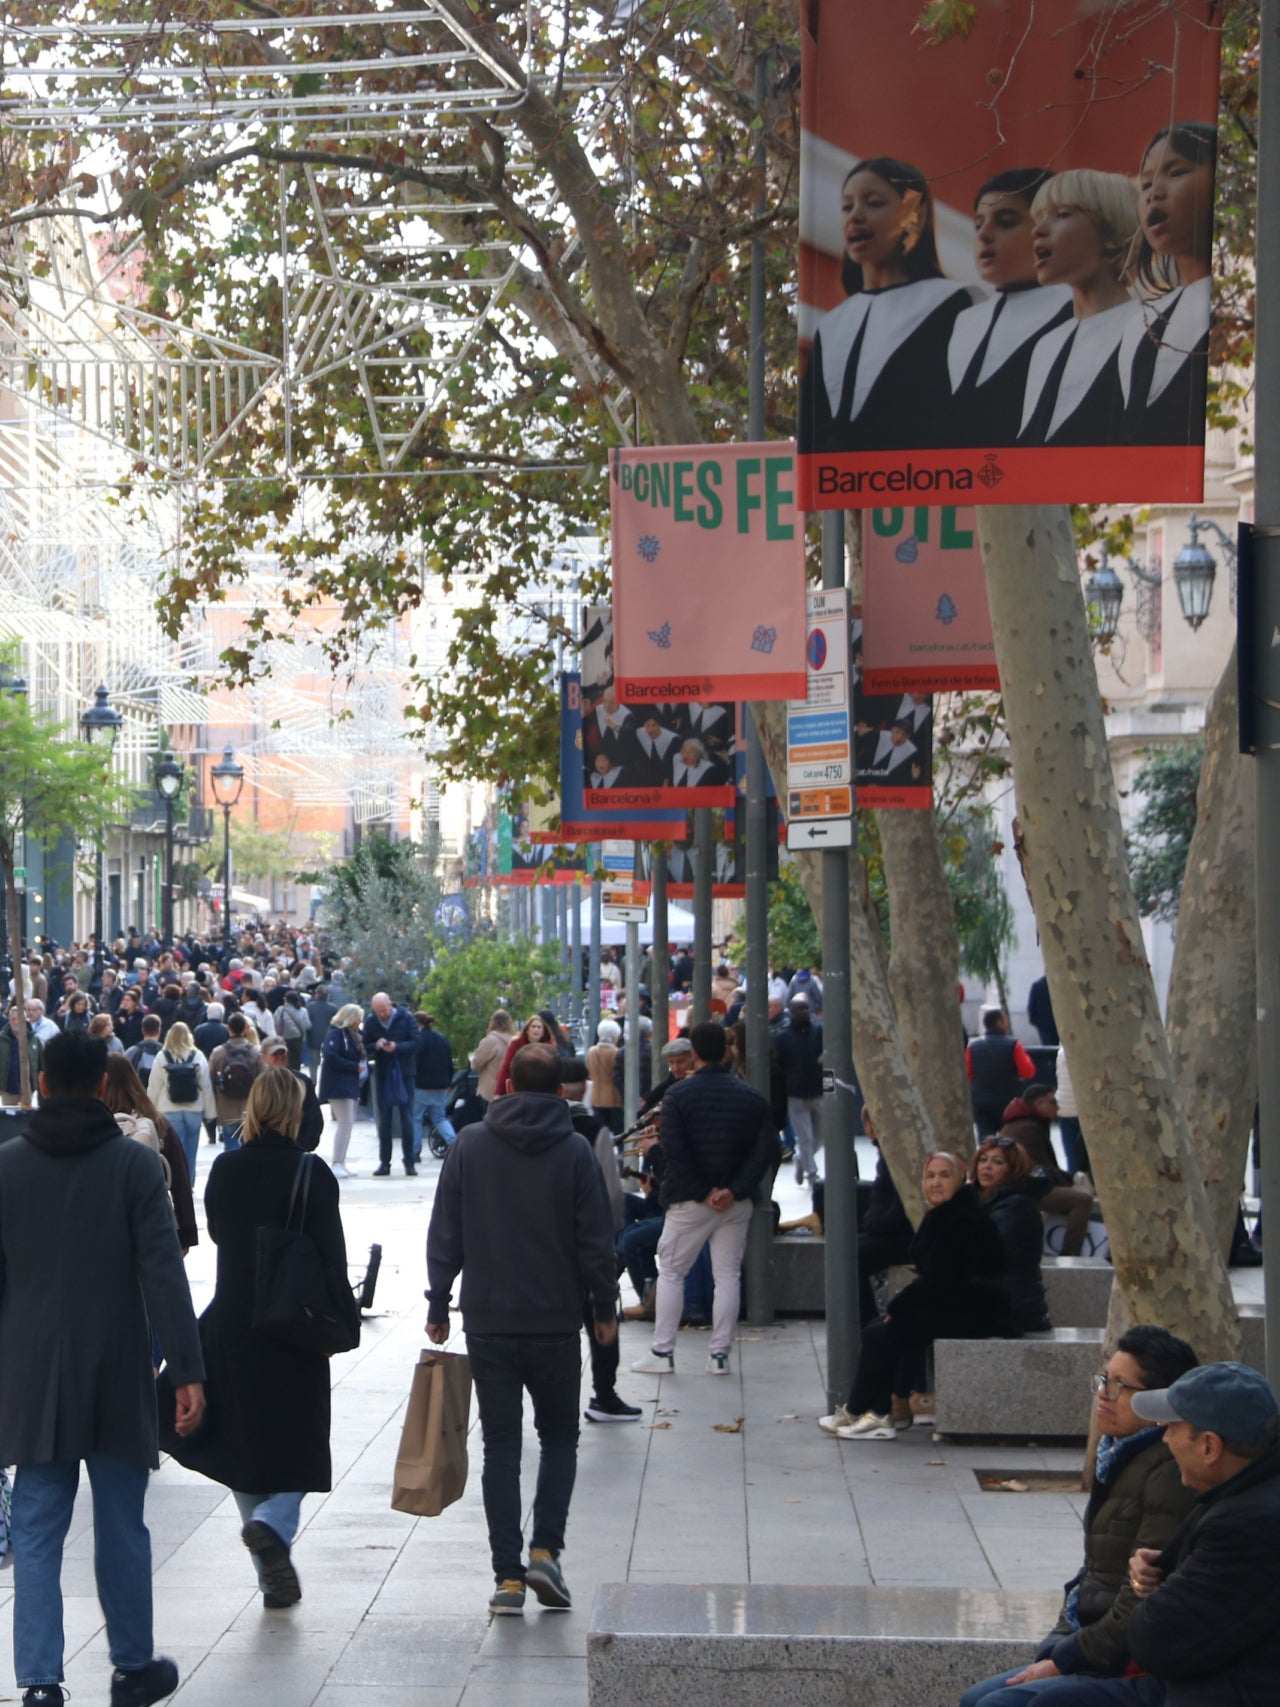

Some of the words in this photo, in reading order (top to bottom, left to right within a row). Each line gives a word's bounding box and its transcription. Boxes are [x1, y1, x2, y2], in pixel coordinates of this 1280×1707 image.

[820, 463, 973, 494] Barcelona
[735, 456, 795, 542] FE
[624, 681, 701, 698] Barcelona
[824, 764, 843, 780] 4750
[590, 792, 651, 806] Barcelona
[566, 823, 619, 836] Barcelona
